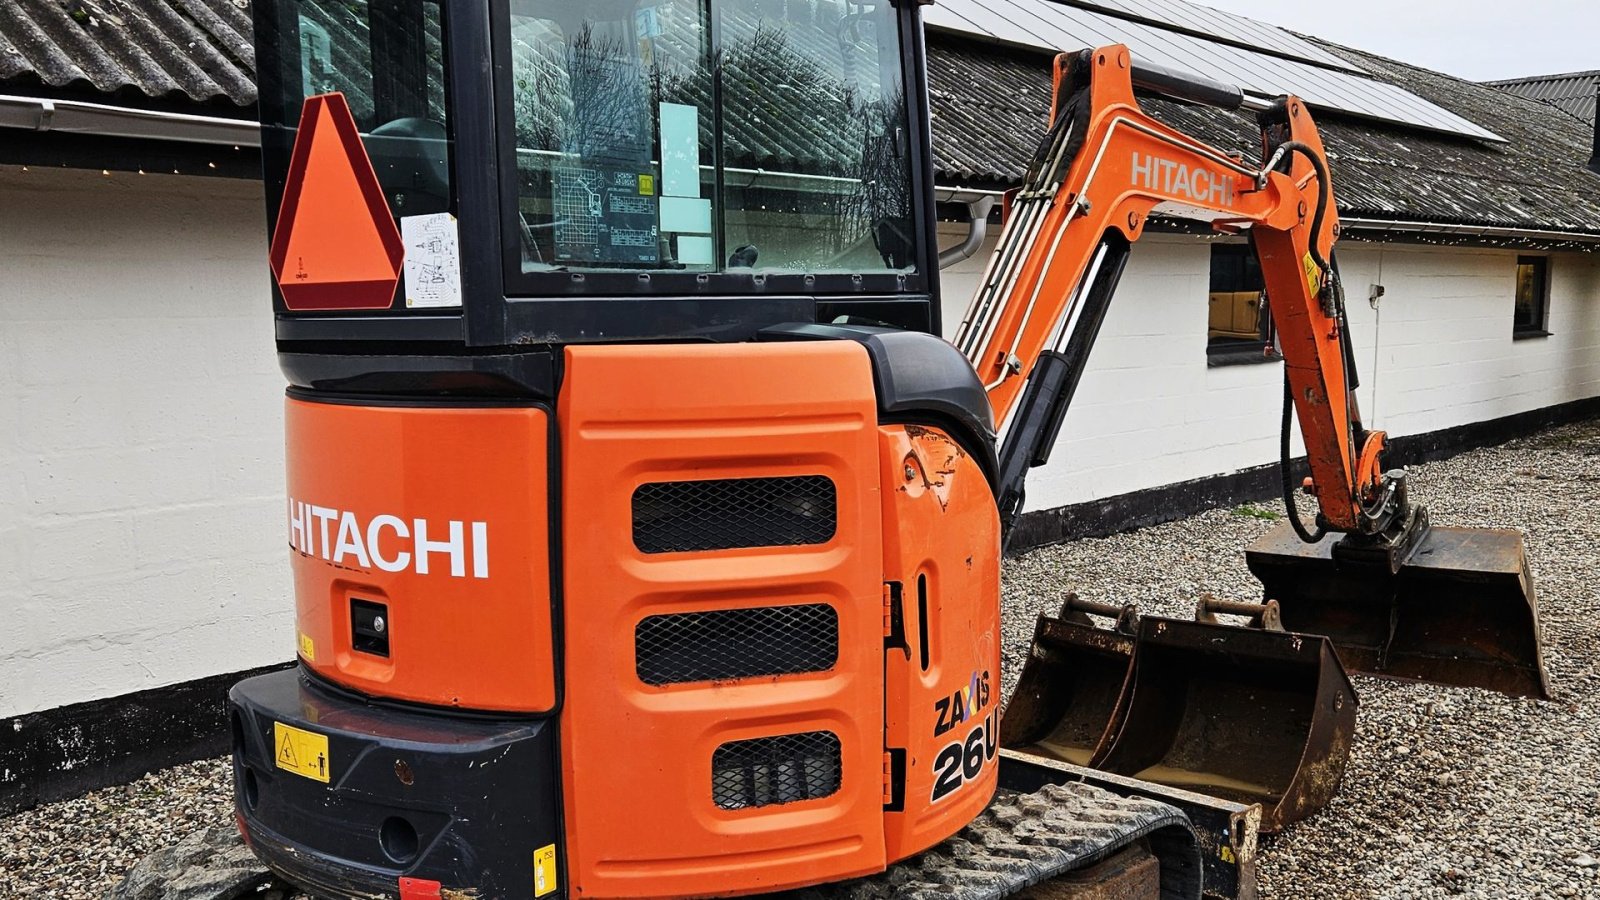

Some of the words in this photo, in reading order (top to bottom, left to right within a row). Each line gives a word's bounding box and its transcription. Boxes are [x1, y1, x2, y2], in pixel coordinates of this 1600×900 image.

[1131, 152, 1233, 207] HITACHI
[289, 497, 489, 579] HITACHI
[933, 670, 990, 738] ZAXIS
[931, 704, 999, 803] 26U
